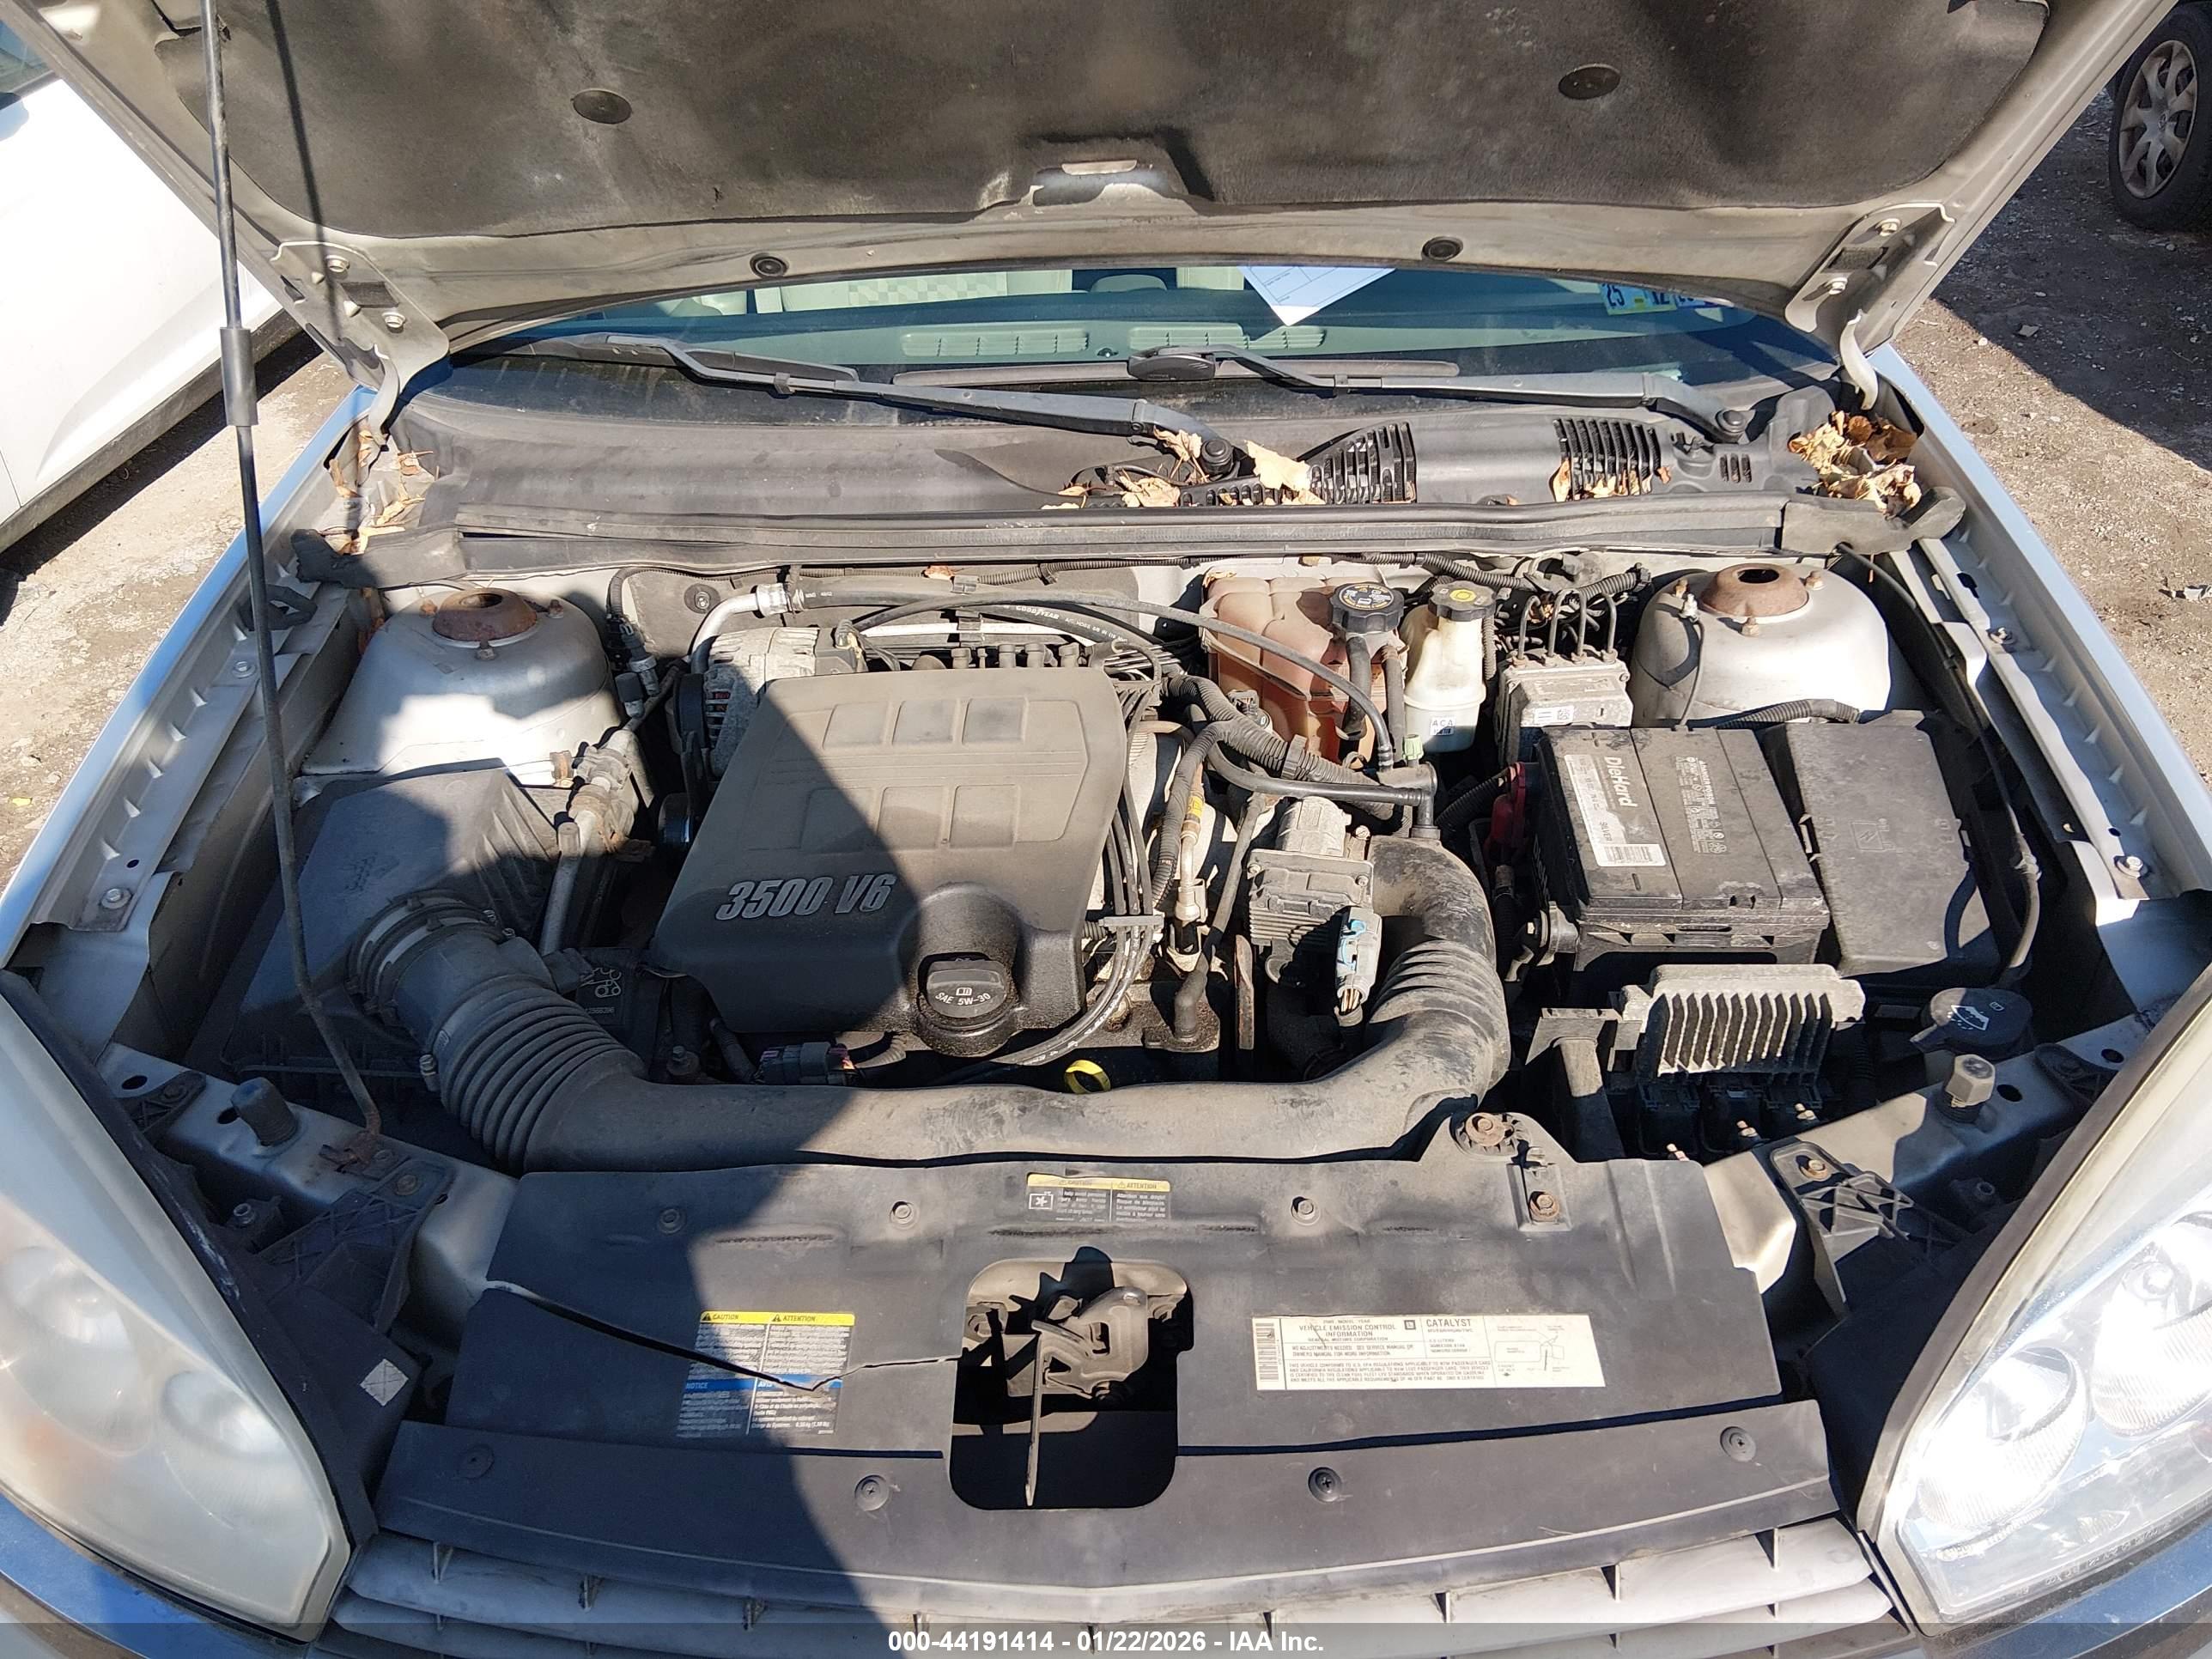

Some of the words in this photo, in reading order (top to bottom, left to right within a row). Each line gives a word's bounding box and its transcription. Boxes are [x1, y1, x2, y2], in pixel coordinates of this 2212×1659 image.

[1016, 605, 1060, 620] GOODYEAR
[715, 876, 834, 921] 3500
[834, 873, 897, 915] V6
[934, 992, 955, 1005] SAE
[957, 992, 991, 1006] 5W-30
[1426, 1318, 1471, 1327] CATALYST
